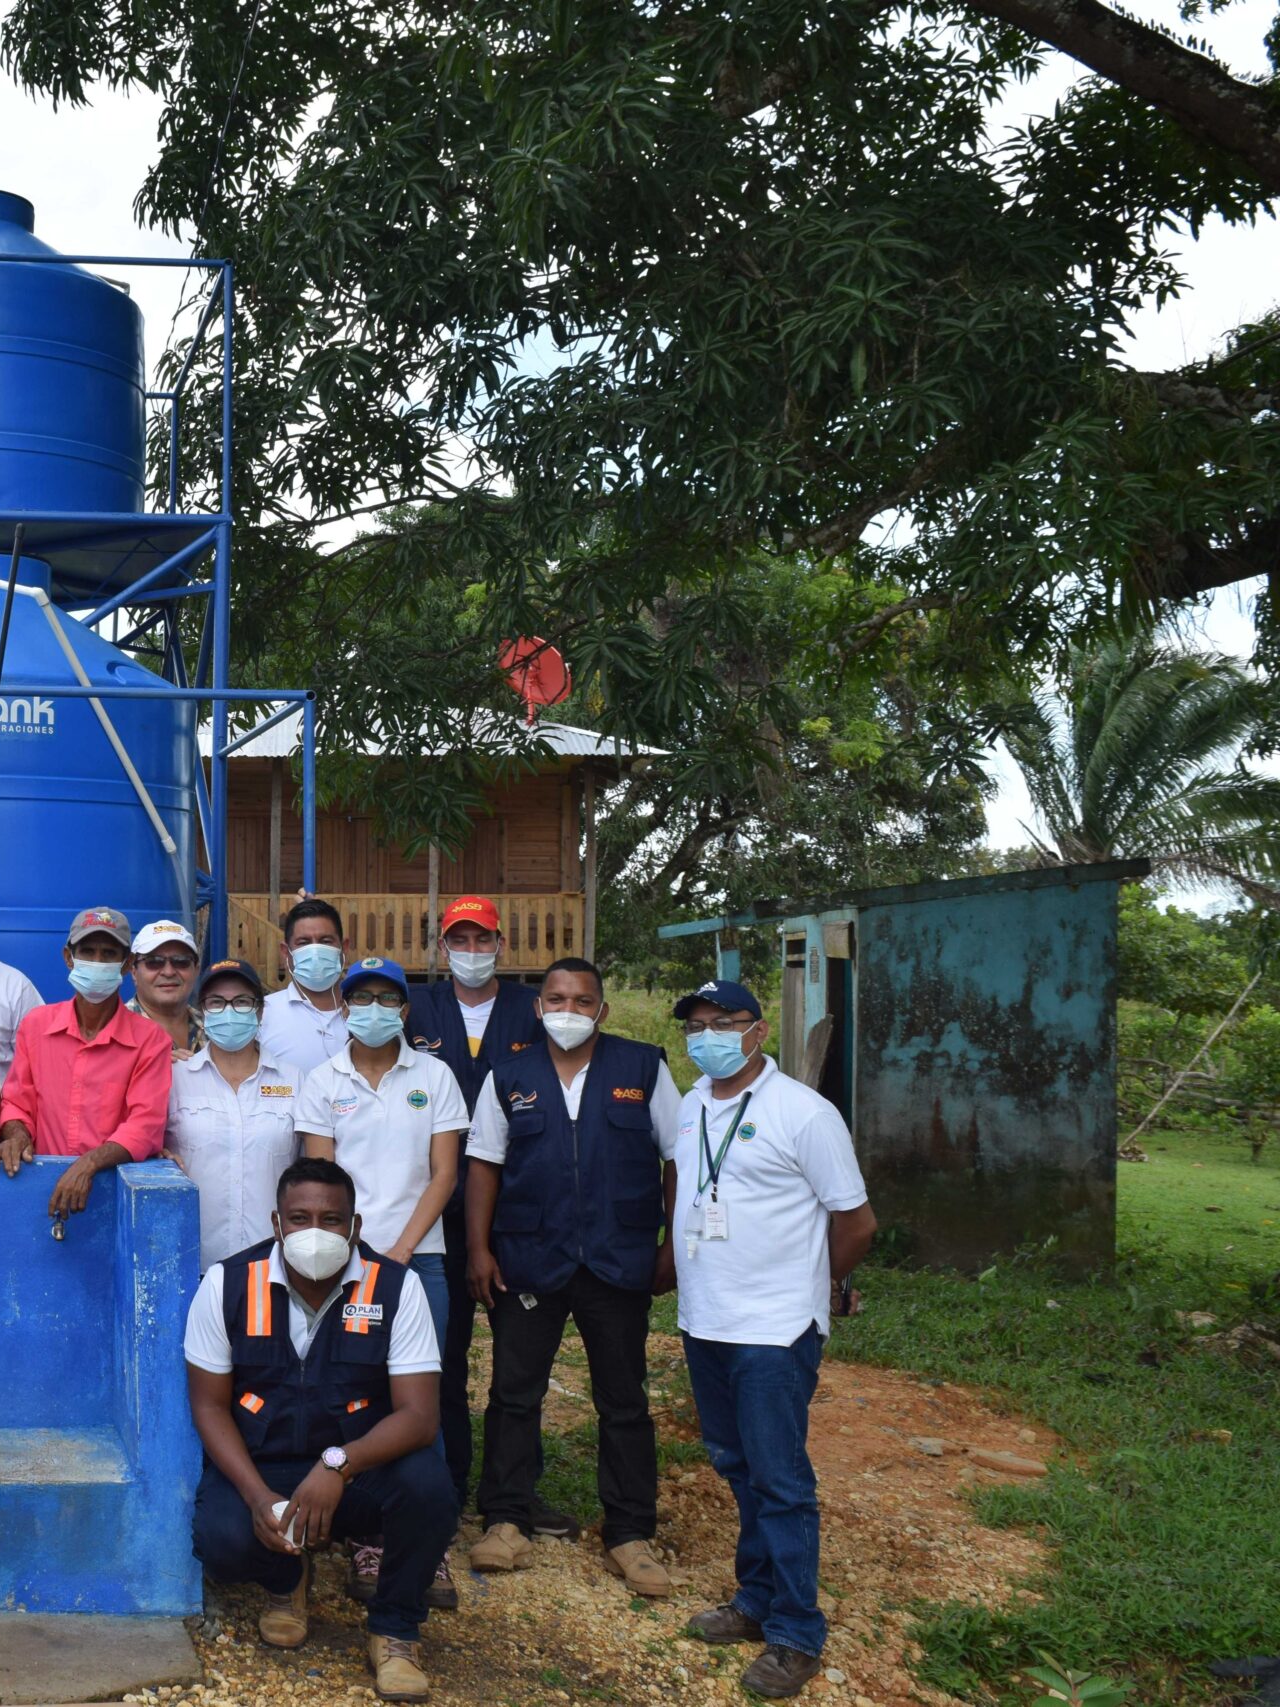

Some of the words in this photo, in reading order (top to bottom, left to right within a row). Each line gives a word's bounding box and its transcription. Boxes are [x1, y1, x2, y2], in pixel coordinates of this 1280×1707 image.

[459, 902, 482, 911] ASB
[622, 1088, 644, 1100] ASB
[358, 1306, 381, 1314] PLAN
